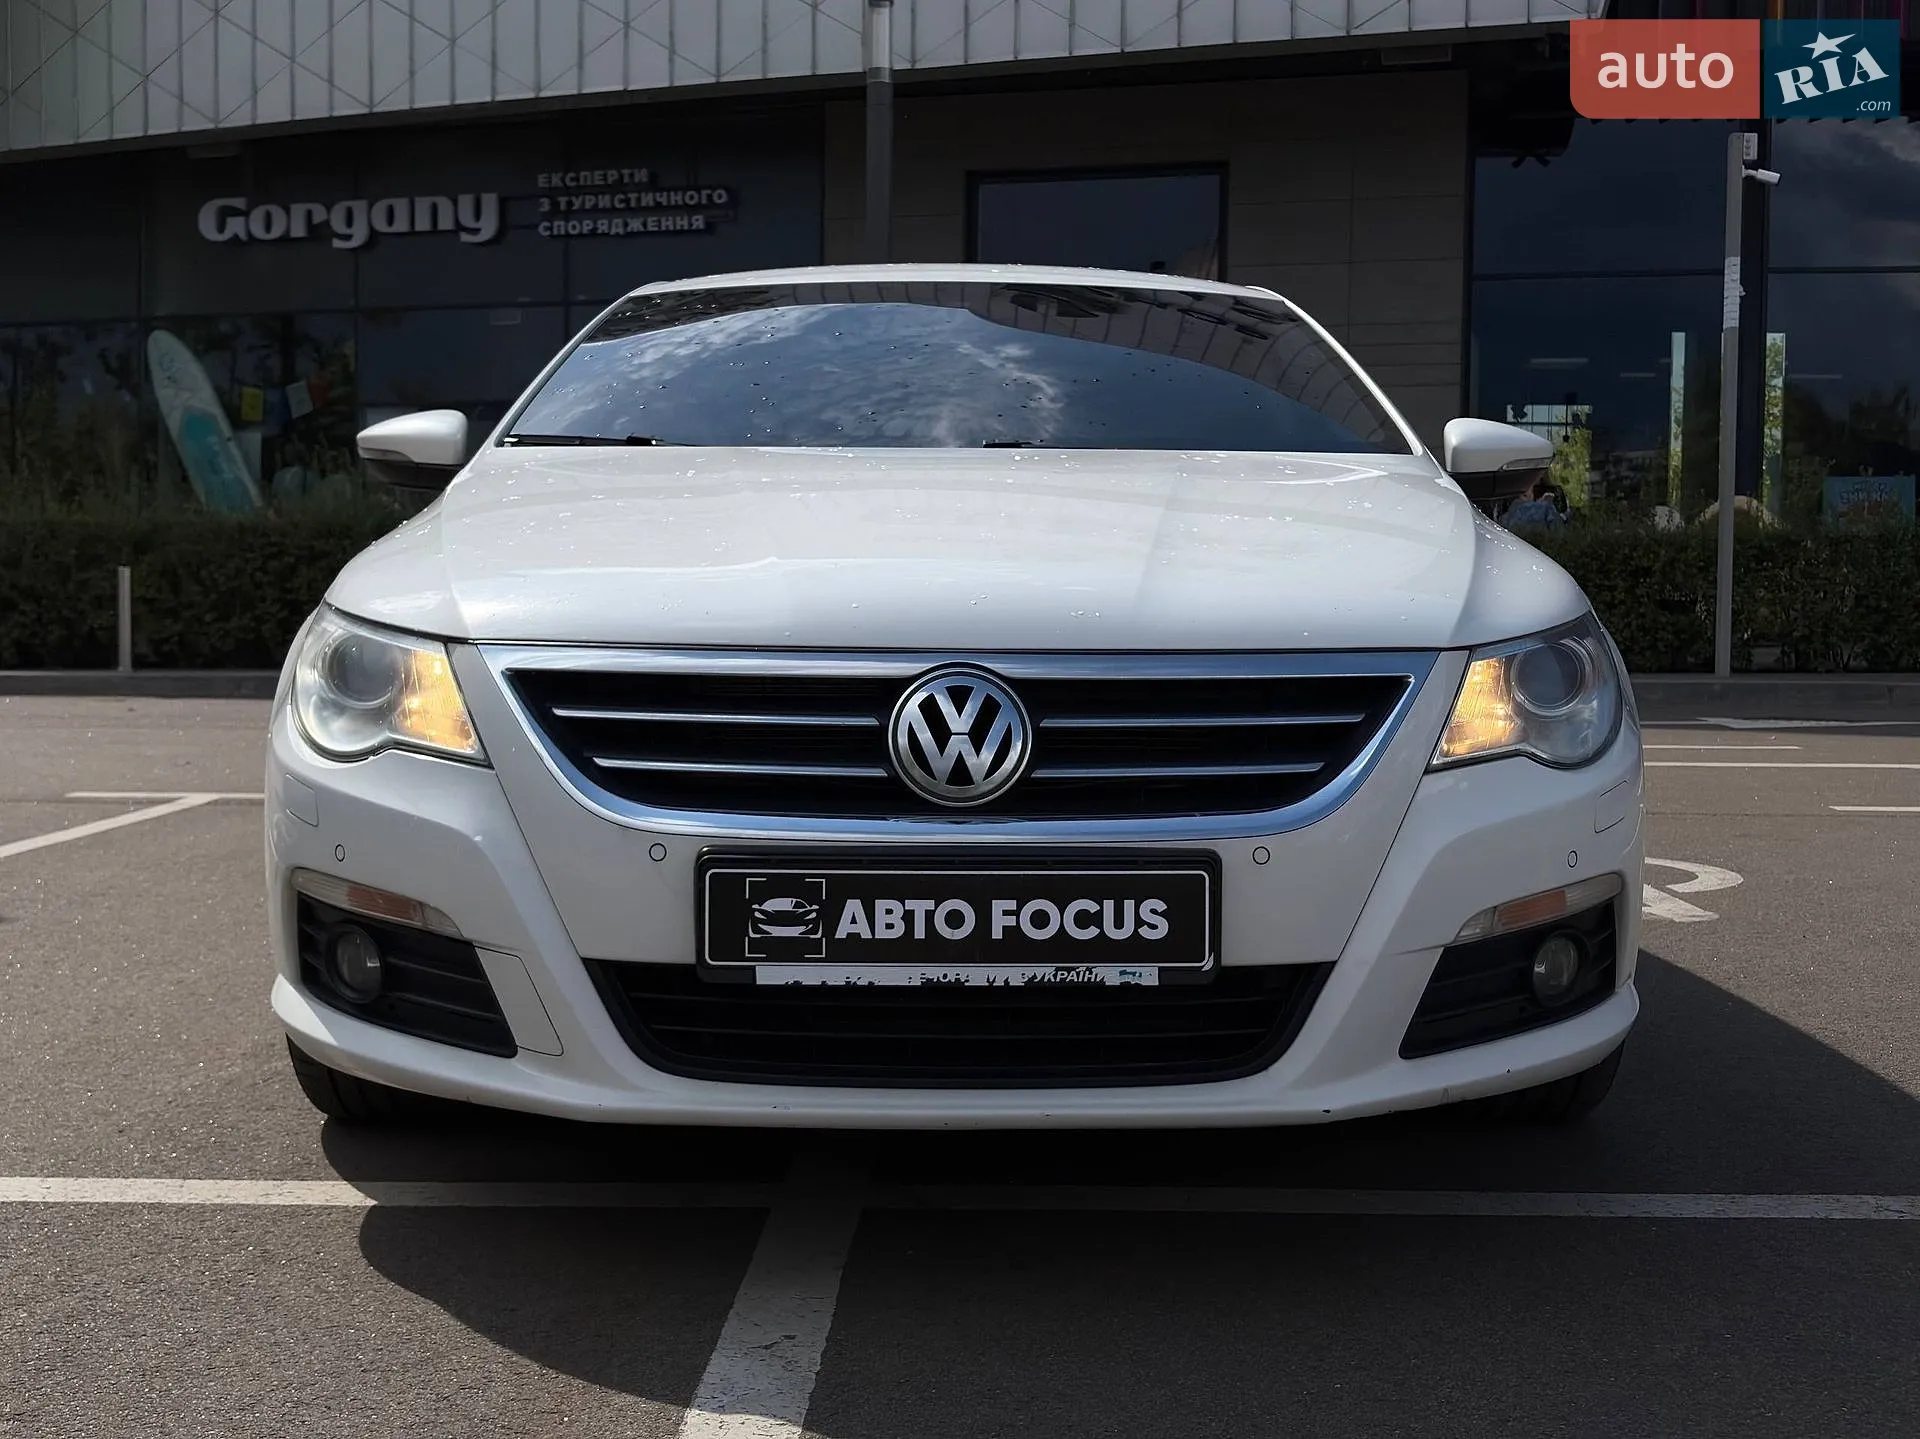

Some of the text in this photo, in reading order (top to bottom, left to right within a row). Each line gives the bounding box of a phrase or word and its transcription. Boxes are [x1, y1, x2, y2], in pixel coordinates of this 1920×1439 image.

[537, 167, 649, 187] ЕКСПЕРТИ
[557, 188, 728, 211] ТУРИСТИЧНОГО
[197, 191, 500, 249] Gorgany
[538, 214, 706, 237] СПОРЯДЖЕННЯ
[834, 898, 1169, 940] АВТО FOCUS
